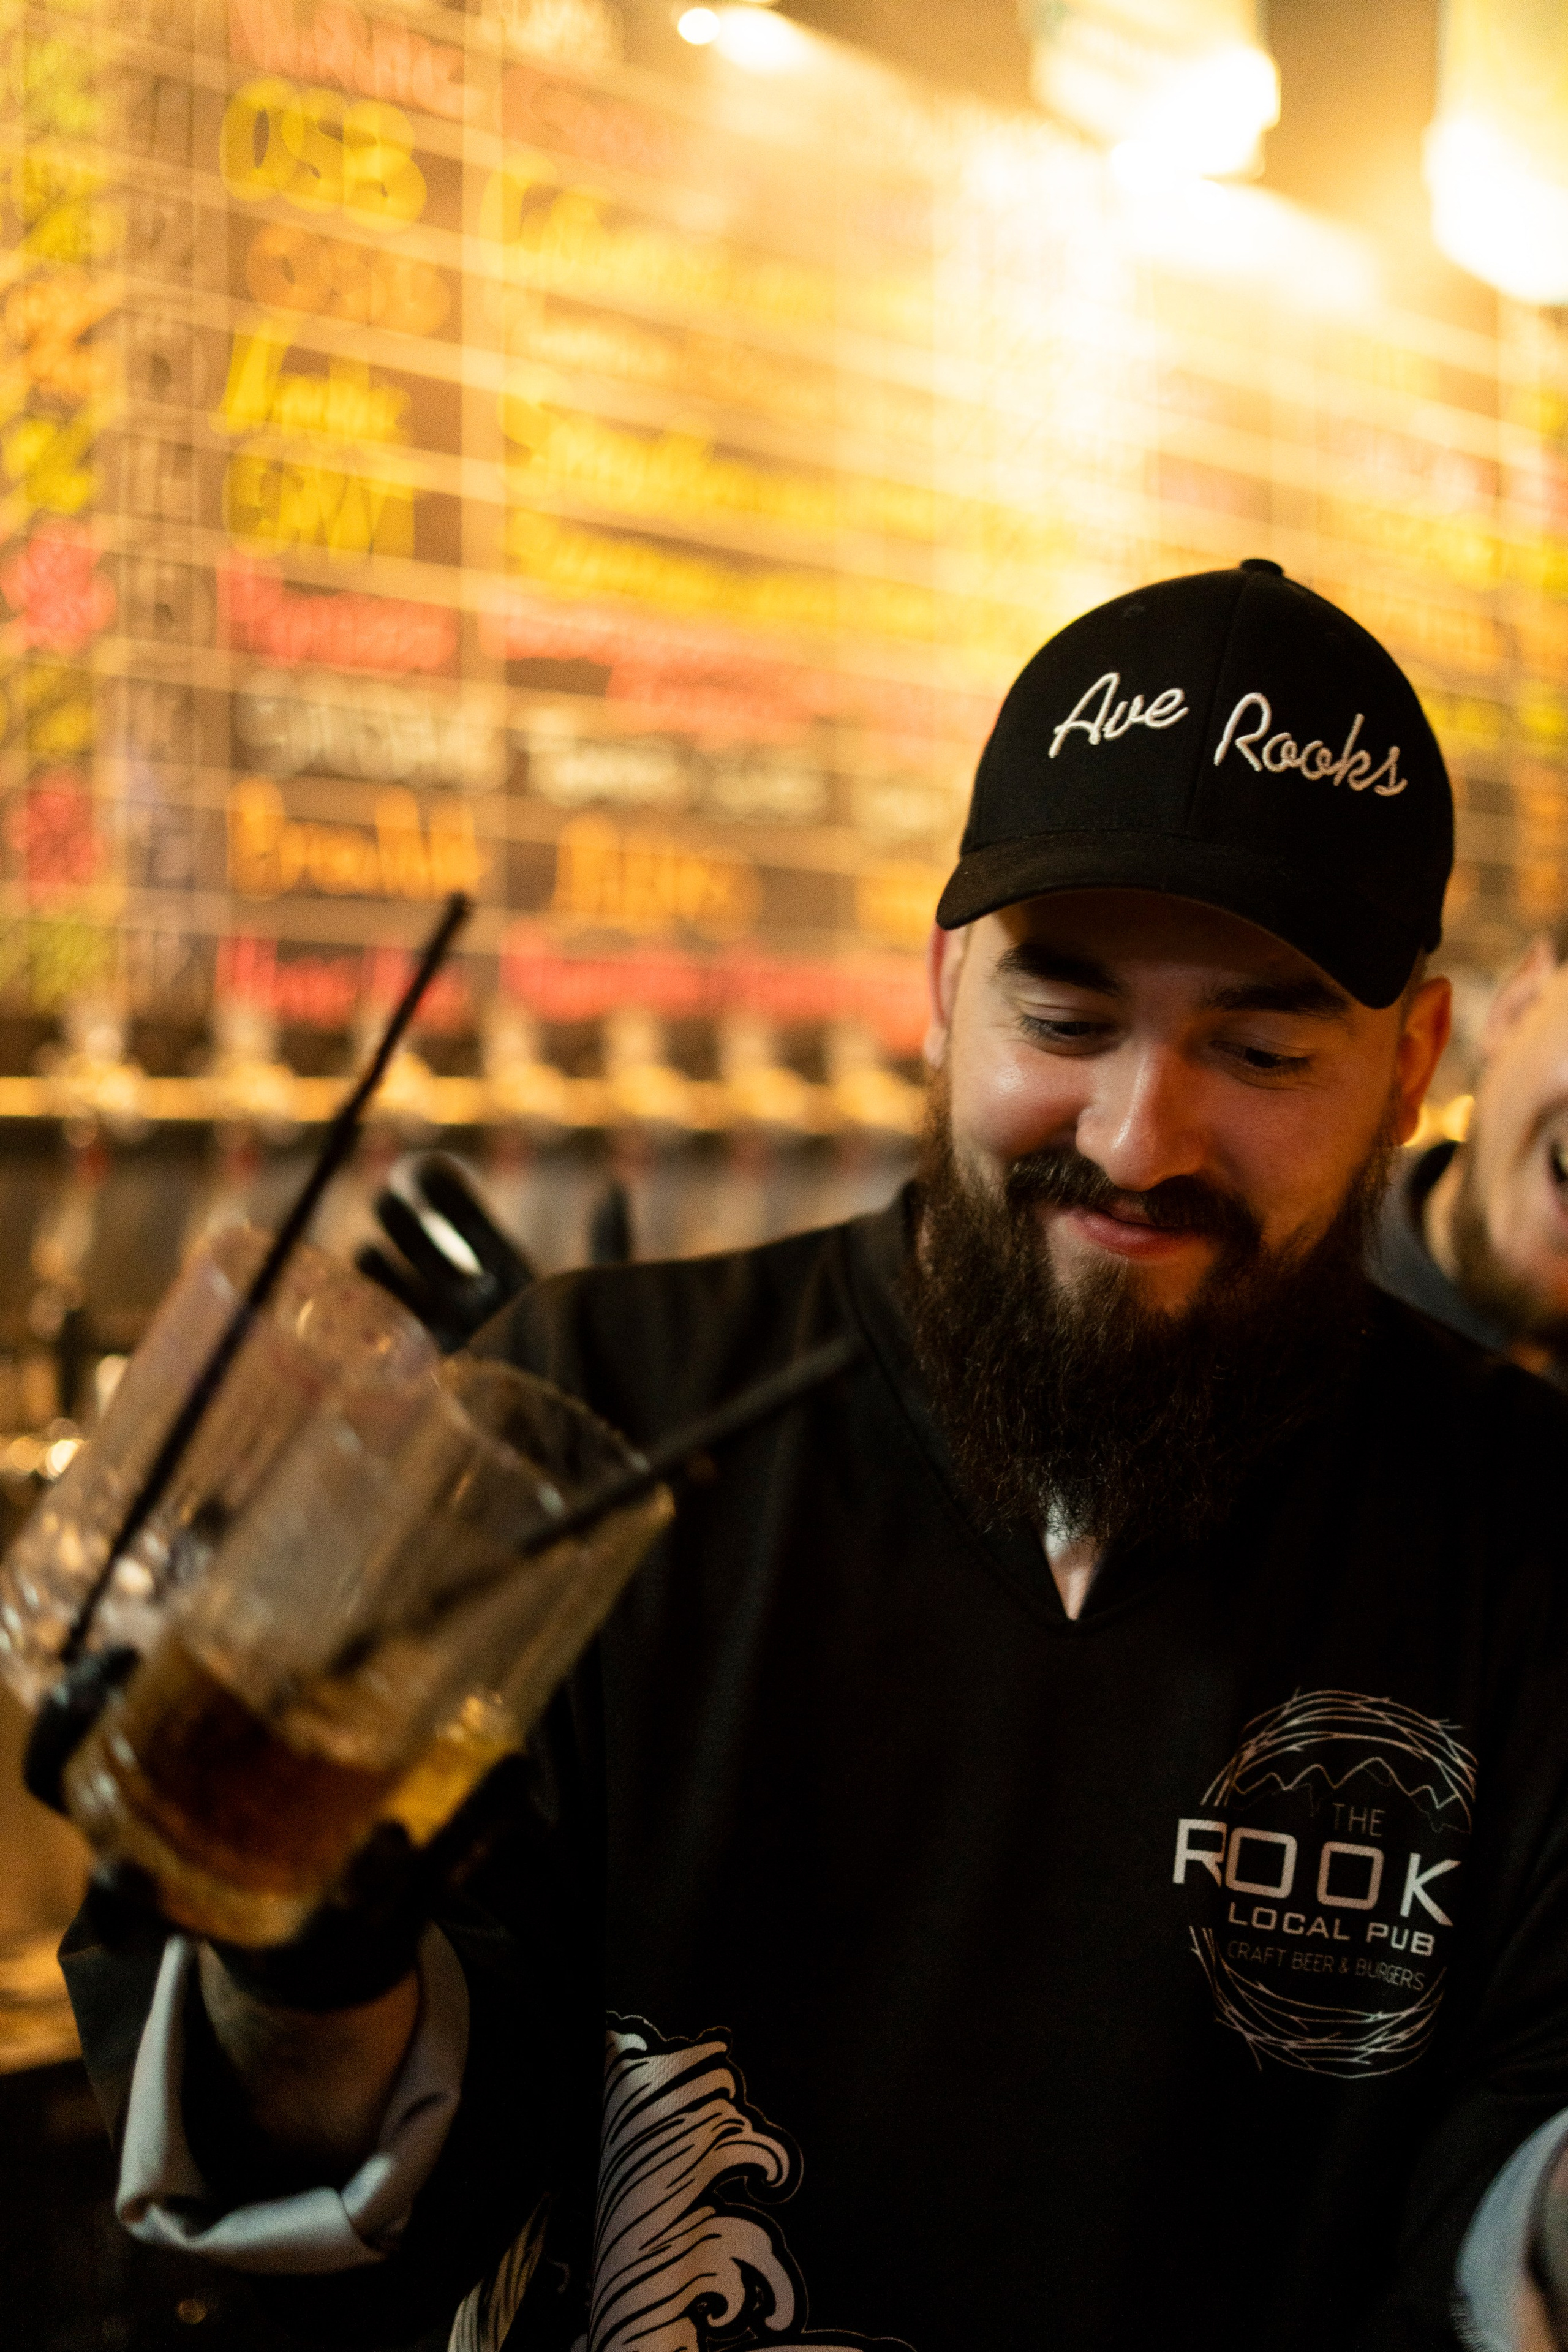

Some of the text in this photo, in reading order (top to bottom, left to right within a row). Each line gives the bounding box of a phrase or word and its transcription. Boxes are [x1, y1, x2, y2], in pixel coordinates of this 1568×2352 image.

[1048, 671, 1189, 759] Ave
[1213, 692, 1408, 796] Rooks
[1333, 1802, 1387, 1838] THE
[1172, 1817, 1462, 1926] ROOK
[1228, 1901, 1436, 1957] LOCAL PUB
[1227, 1940, 1427, 1992] CRAFT BEER & BURGERS
